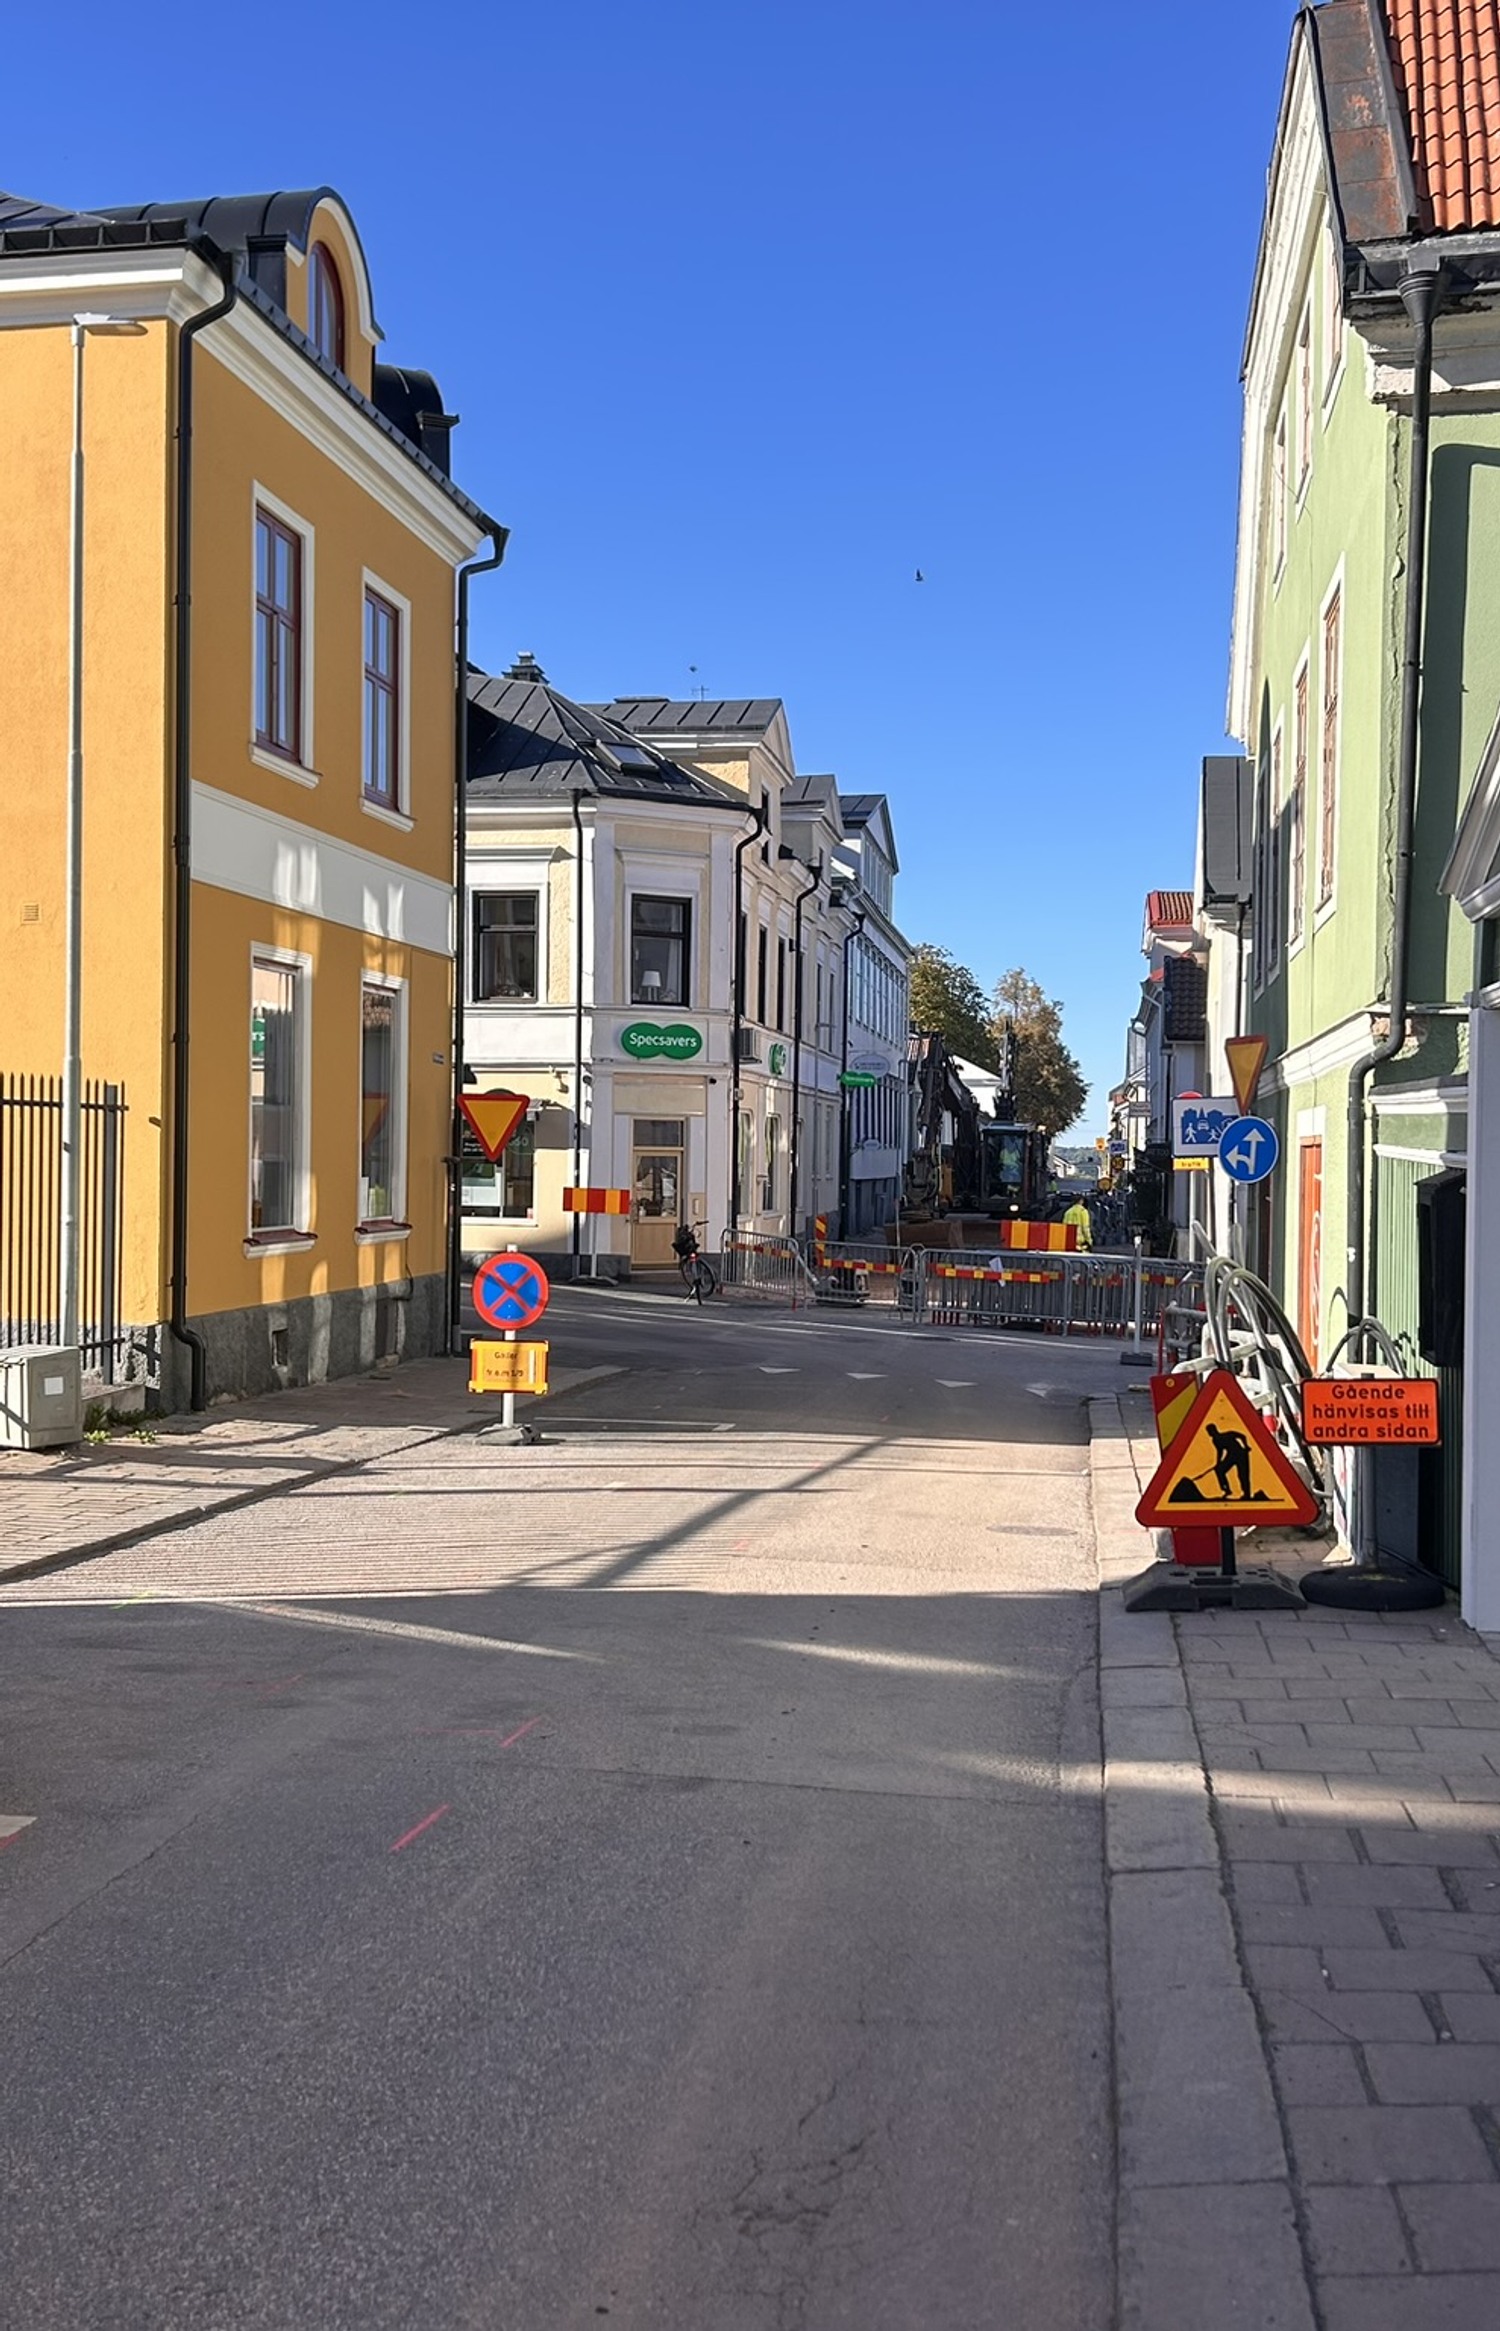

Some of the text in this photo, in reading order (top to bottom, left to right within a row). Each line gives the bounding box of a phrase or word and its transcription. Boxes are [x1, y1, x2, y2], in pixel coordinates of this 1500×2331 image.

[629, 1032, 698, 1048] Specsavers
[1331, 1384, 1406, 1400] Gående
[1311, 1403, 1400, 1420] hänvisas
[1312, 1422, 1430, 1439] andra sidan
